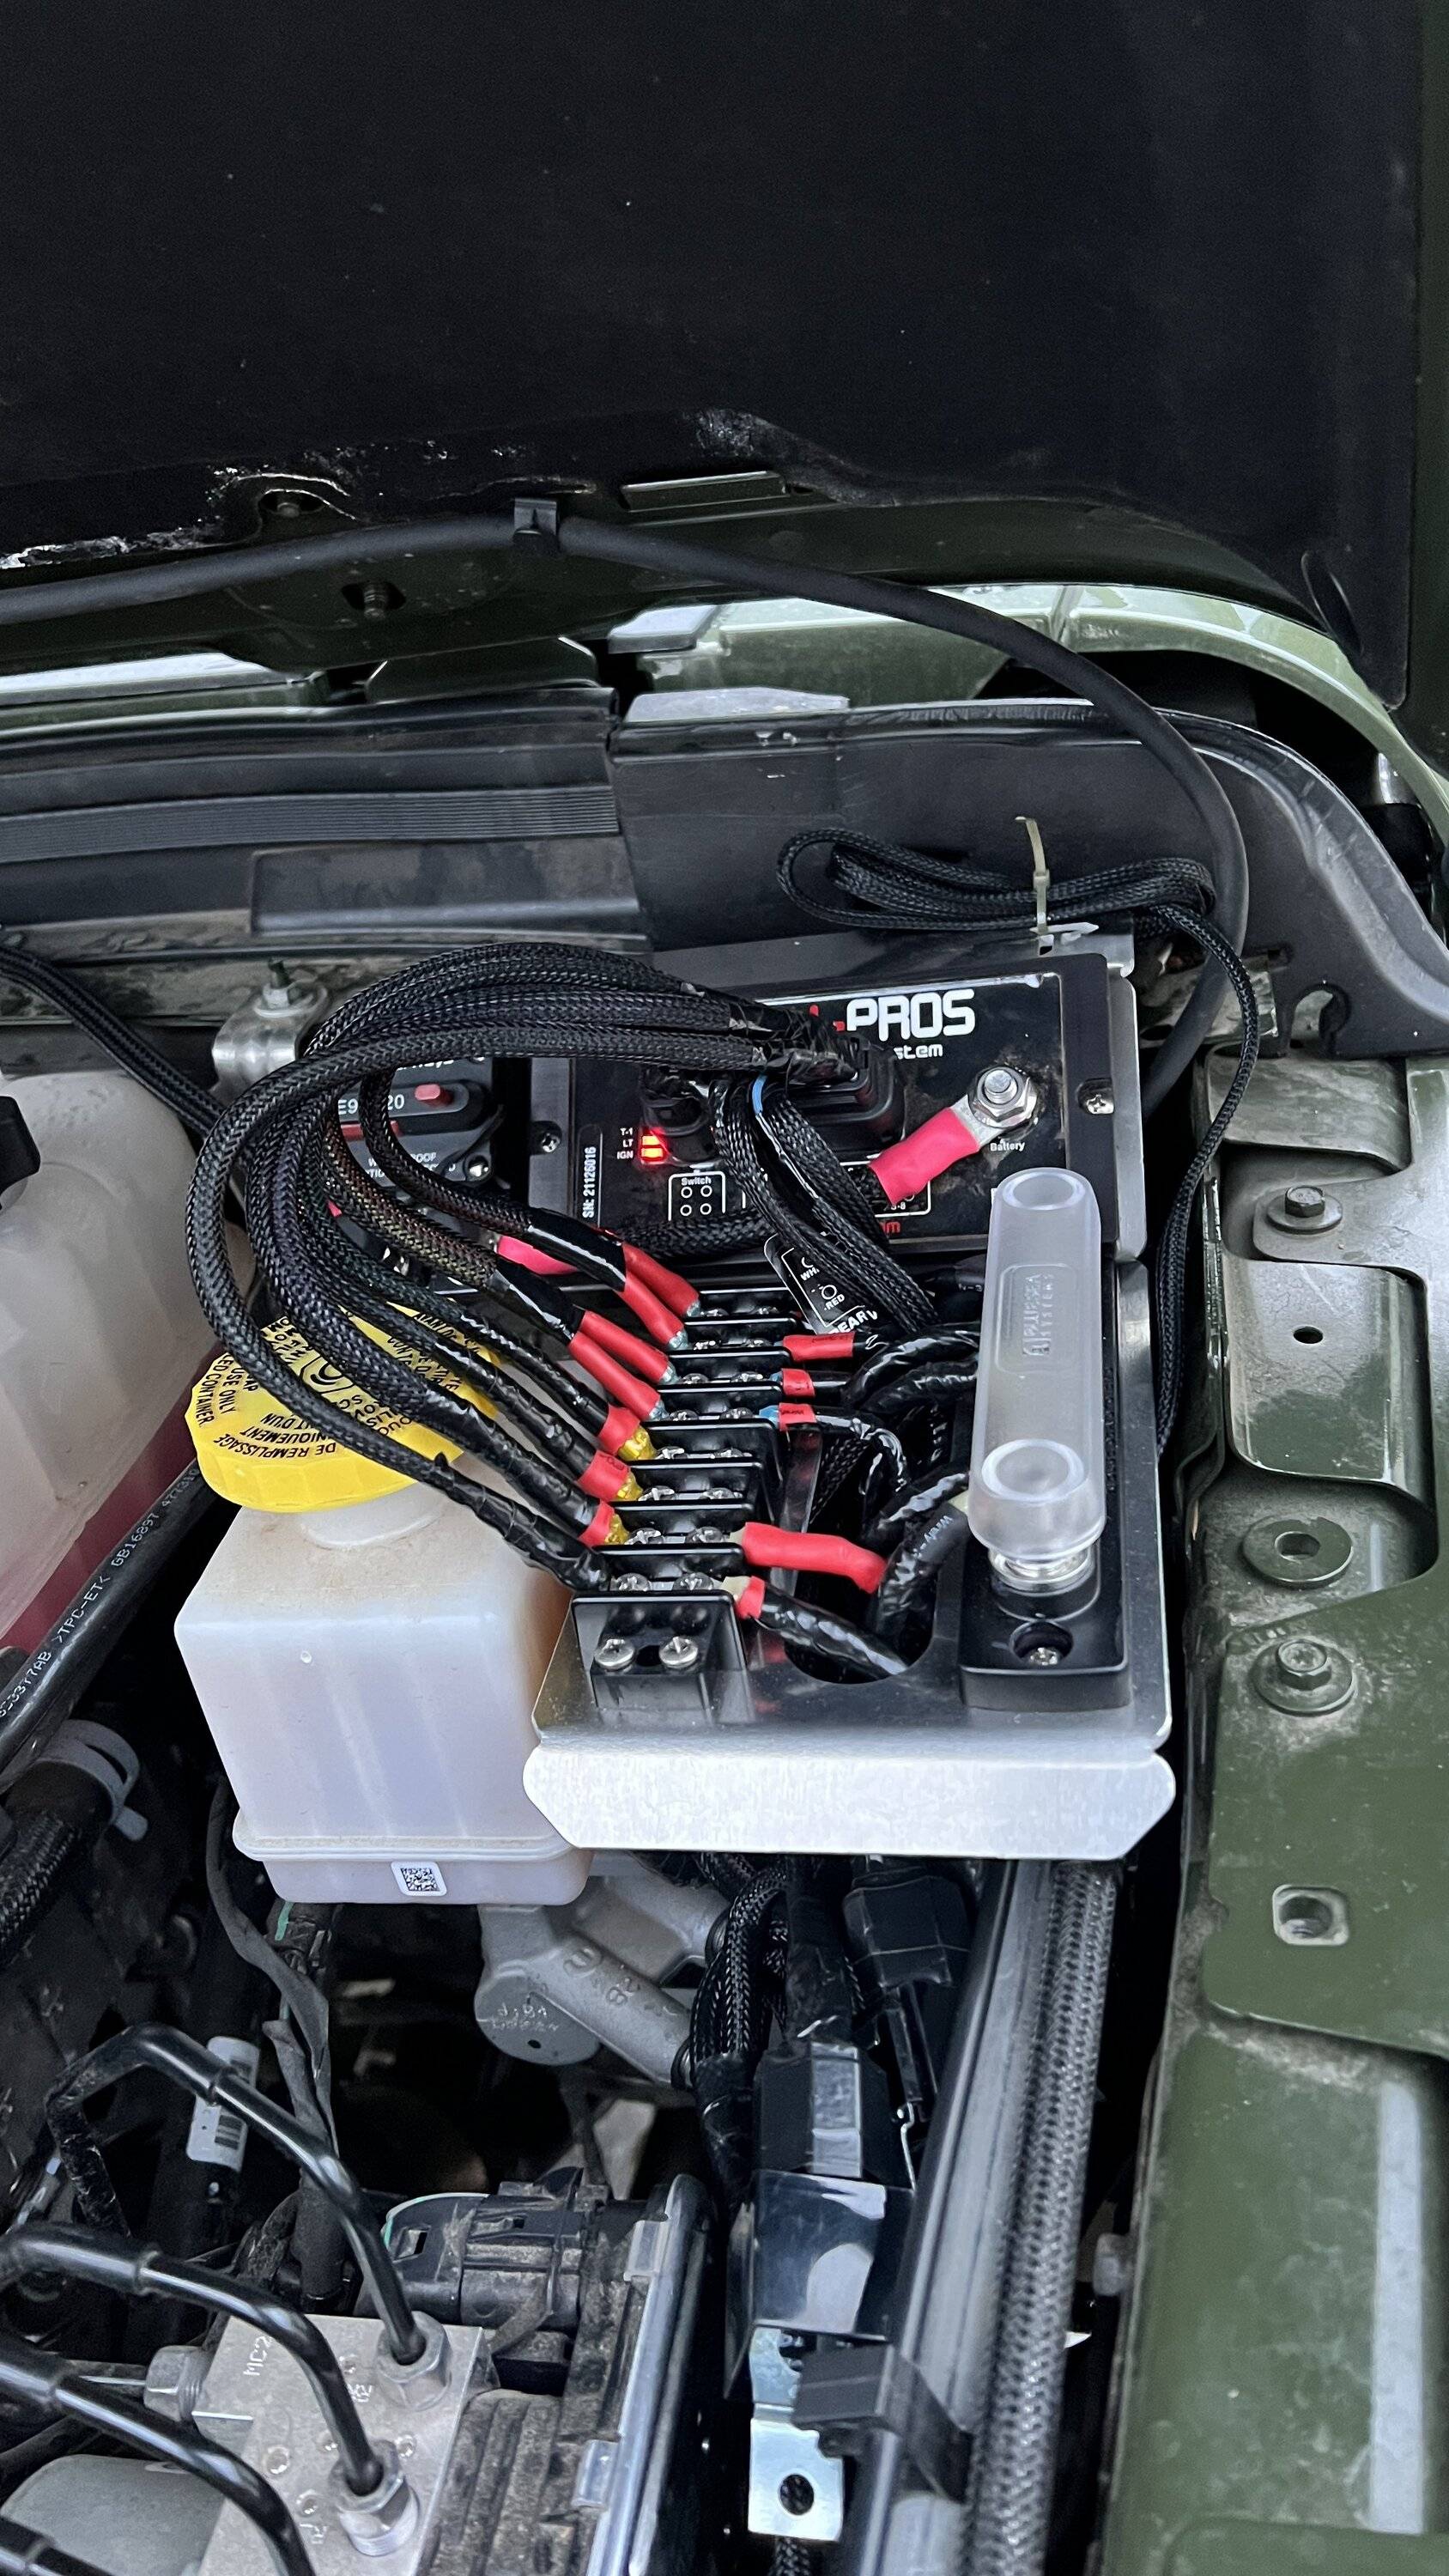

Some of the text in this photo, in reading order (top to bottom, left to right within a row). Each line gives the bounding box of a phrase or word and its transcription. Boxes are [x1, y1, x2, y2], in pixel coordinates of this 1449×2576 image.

[846, 988, 976, 1042] PROS
[620, 1127, 634, 1136] T-1
[622, 1139, 634, 1148] LT
[990, 1142, 1026, 1152] Battery
[616, 1150, 634, 1160] IGN
[583, 1146, 597, 1197] 21126016
[681, 1176, 712, 1187] Switch
[218, 1367, 245, 1414] USE ONLY
[196, 1374, 221, 1426] CONTAINER
[240, 1426, 331, 1444] NIQUEMENT
[213, 1433, 336, 1458] DE REMPLISSAGE
